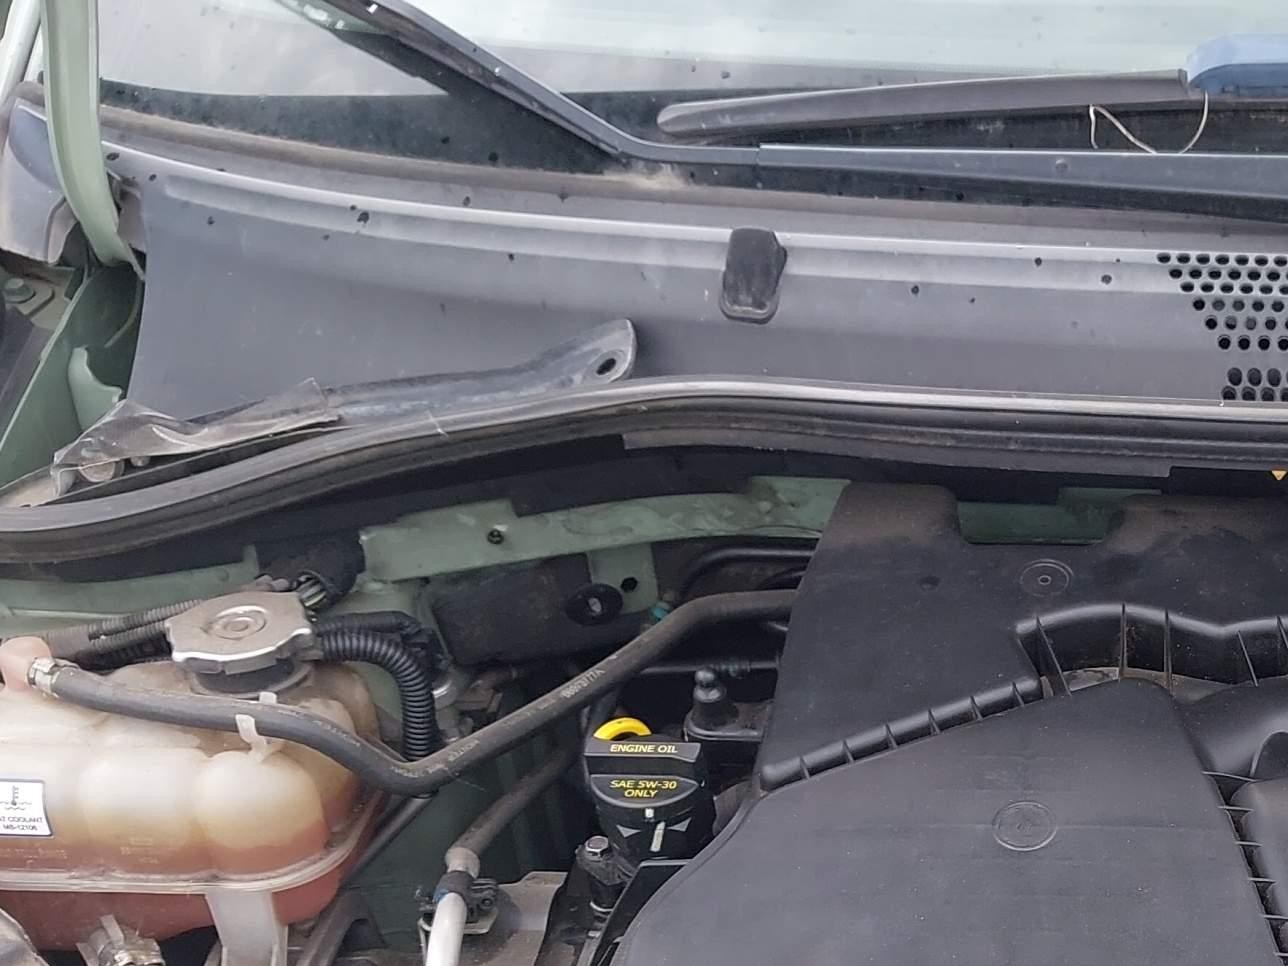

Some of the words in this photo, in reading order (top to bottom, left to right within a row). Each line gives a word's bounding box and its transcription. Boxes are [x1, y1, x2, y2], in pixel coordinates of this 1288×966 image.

[609, 744, 655, 753] ENGINE
[657, 744, 678, 754] OIL
[609, 779, 635, 788] SAE
[637, 780, 678, 789] 5W-30
[623, 789, 658, 798] ONLY
